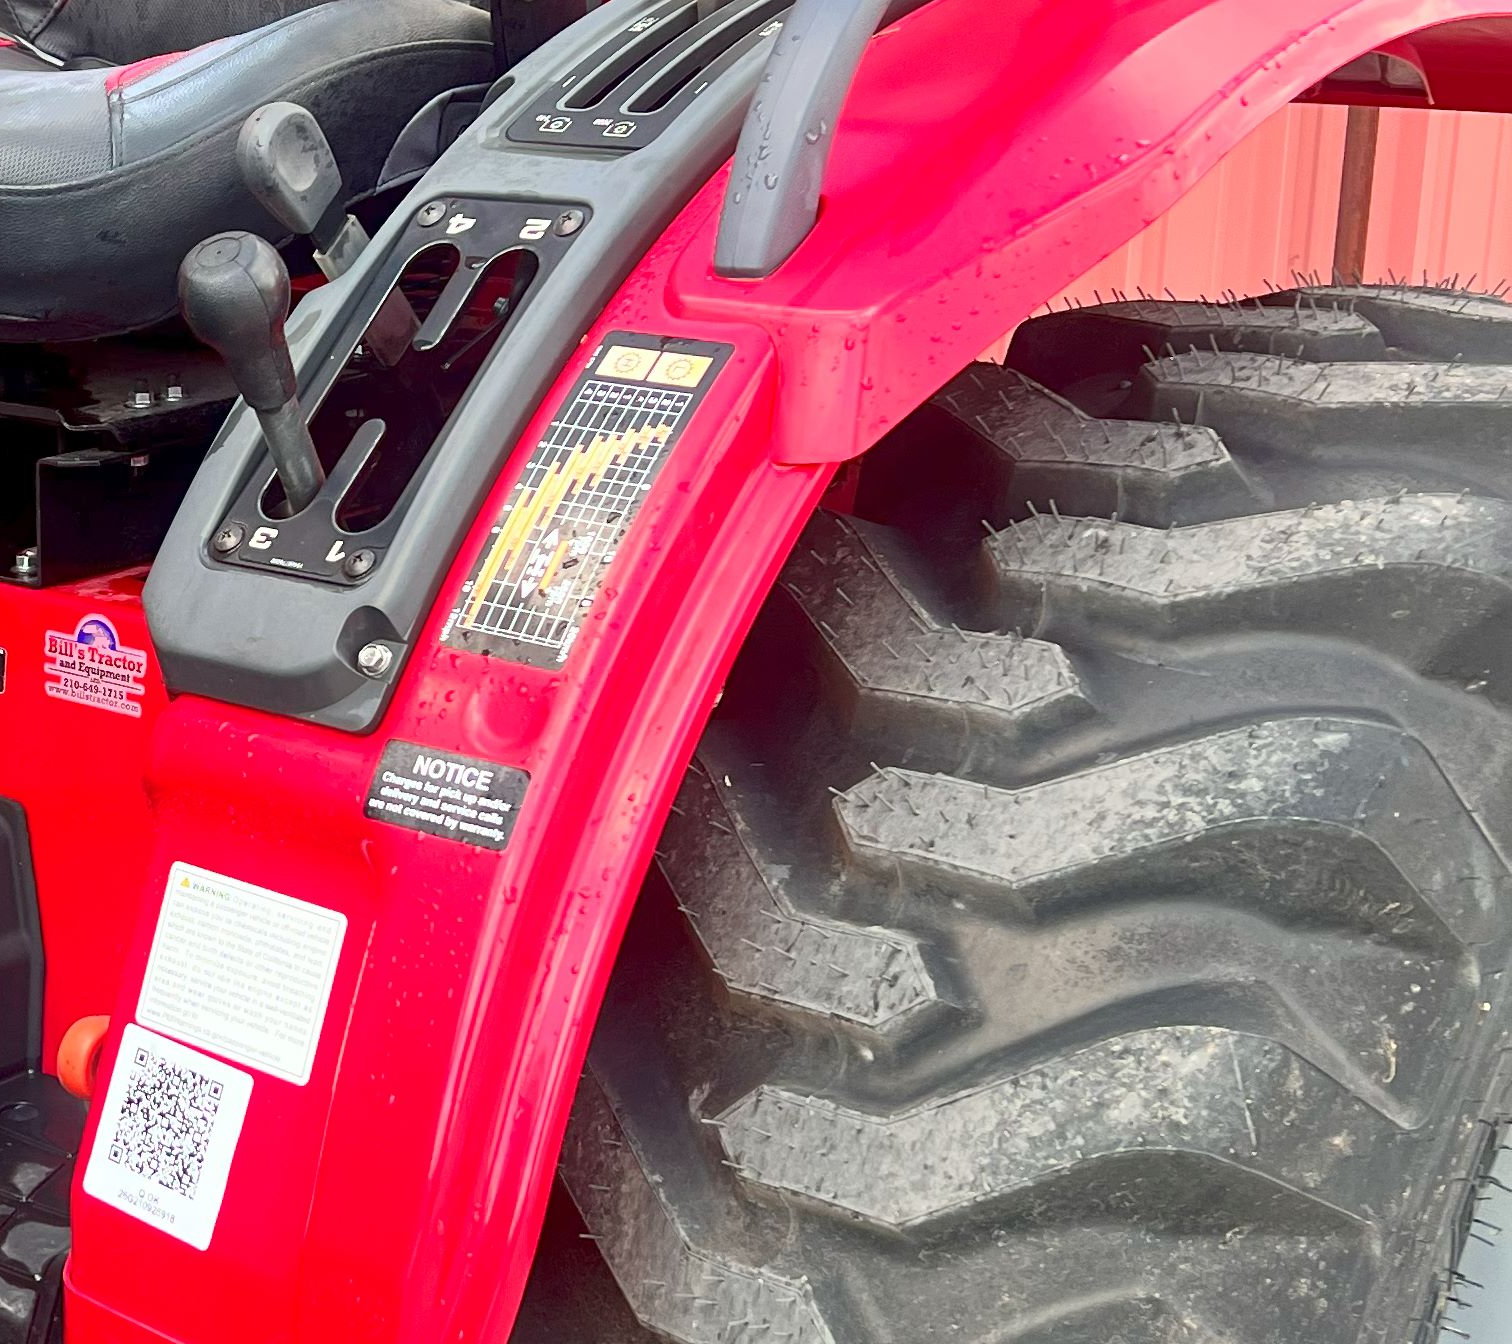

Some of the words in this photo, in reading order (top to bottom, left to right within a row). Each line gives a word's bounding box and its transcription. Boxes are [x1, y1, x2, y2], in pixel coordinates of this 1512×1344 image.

[445, 213, 477, 234] 4
[519, 218, 552, 240] 2
[249, 527, 279, 549] 3
[325, 540, 346, 562] 1
[48, 637, 85, 660] Bill's
[88, 647, 143, 673] Tractor
[59, 659, 76, 669] and
[78, 662, 130, 683] Equipment
[48, 686, 139, 712] www.billstractor.com
[63, 678, 124, 700] 210-649-1715
[413, 754, 494, 792] NOTICE
[382, 771, 423, 791] Charges
[423, 781, 441, 794] for
[439, 786, 462, 800] pick
[462, 793, 477, 805] up
[477, 795, 512, 812] and/or
[380, 785, 420, 805] delivery
[420, 796, 441, 809] and
[440, 801, 478, 818] service
[478, 812, 504, 825] calls
[369, 798, 385, 809] are
[385, 802, 404, 814] not
[403, 806, 444, 824] covered
[444, 815, 459, 831] by
[459, 821, 505, 841] warranty.
